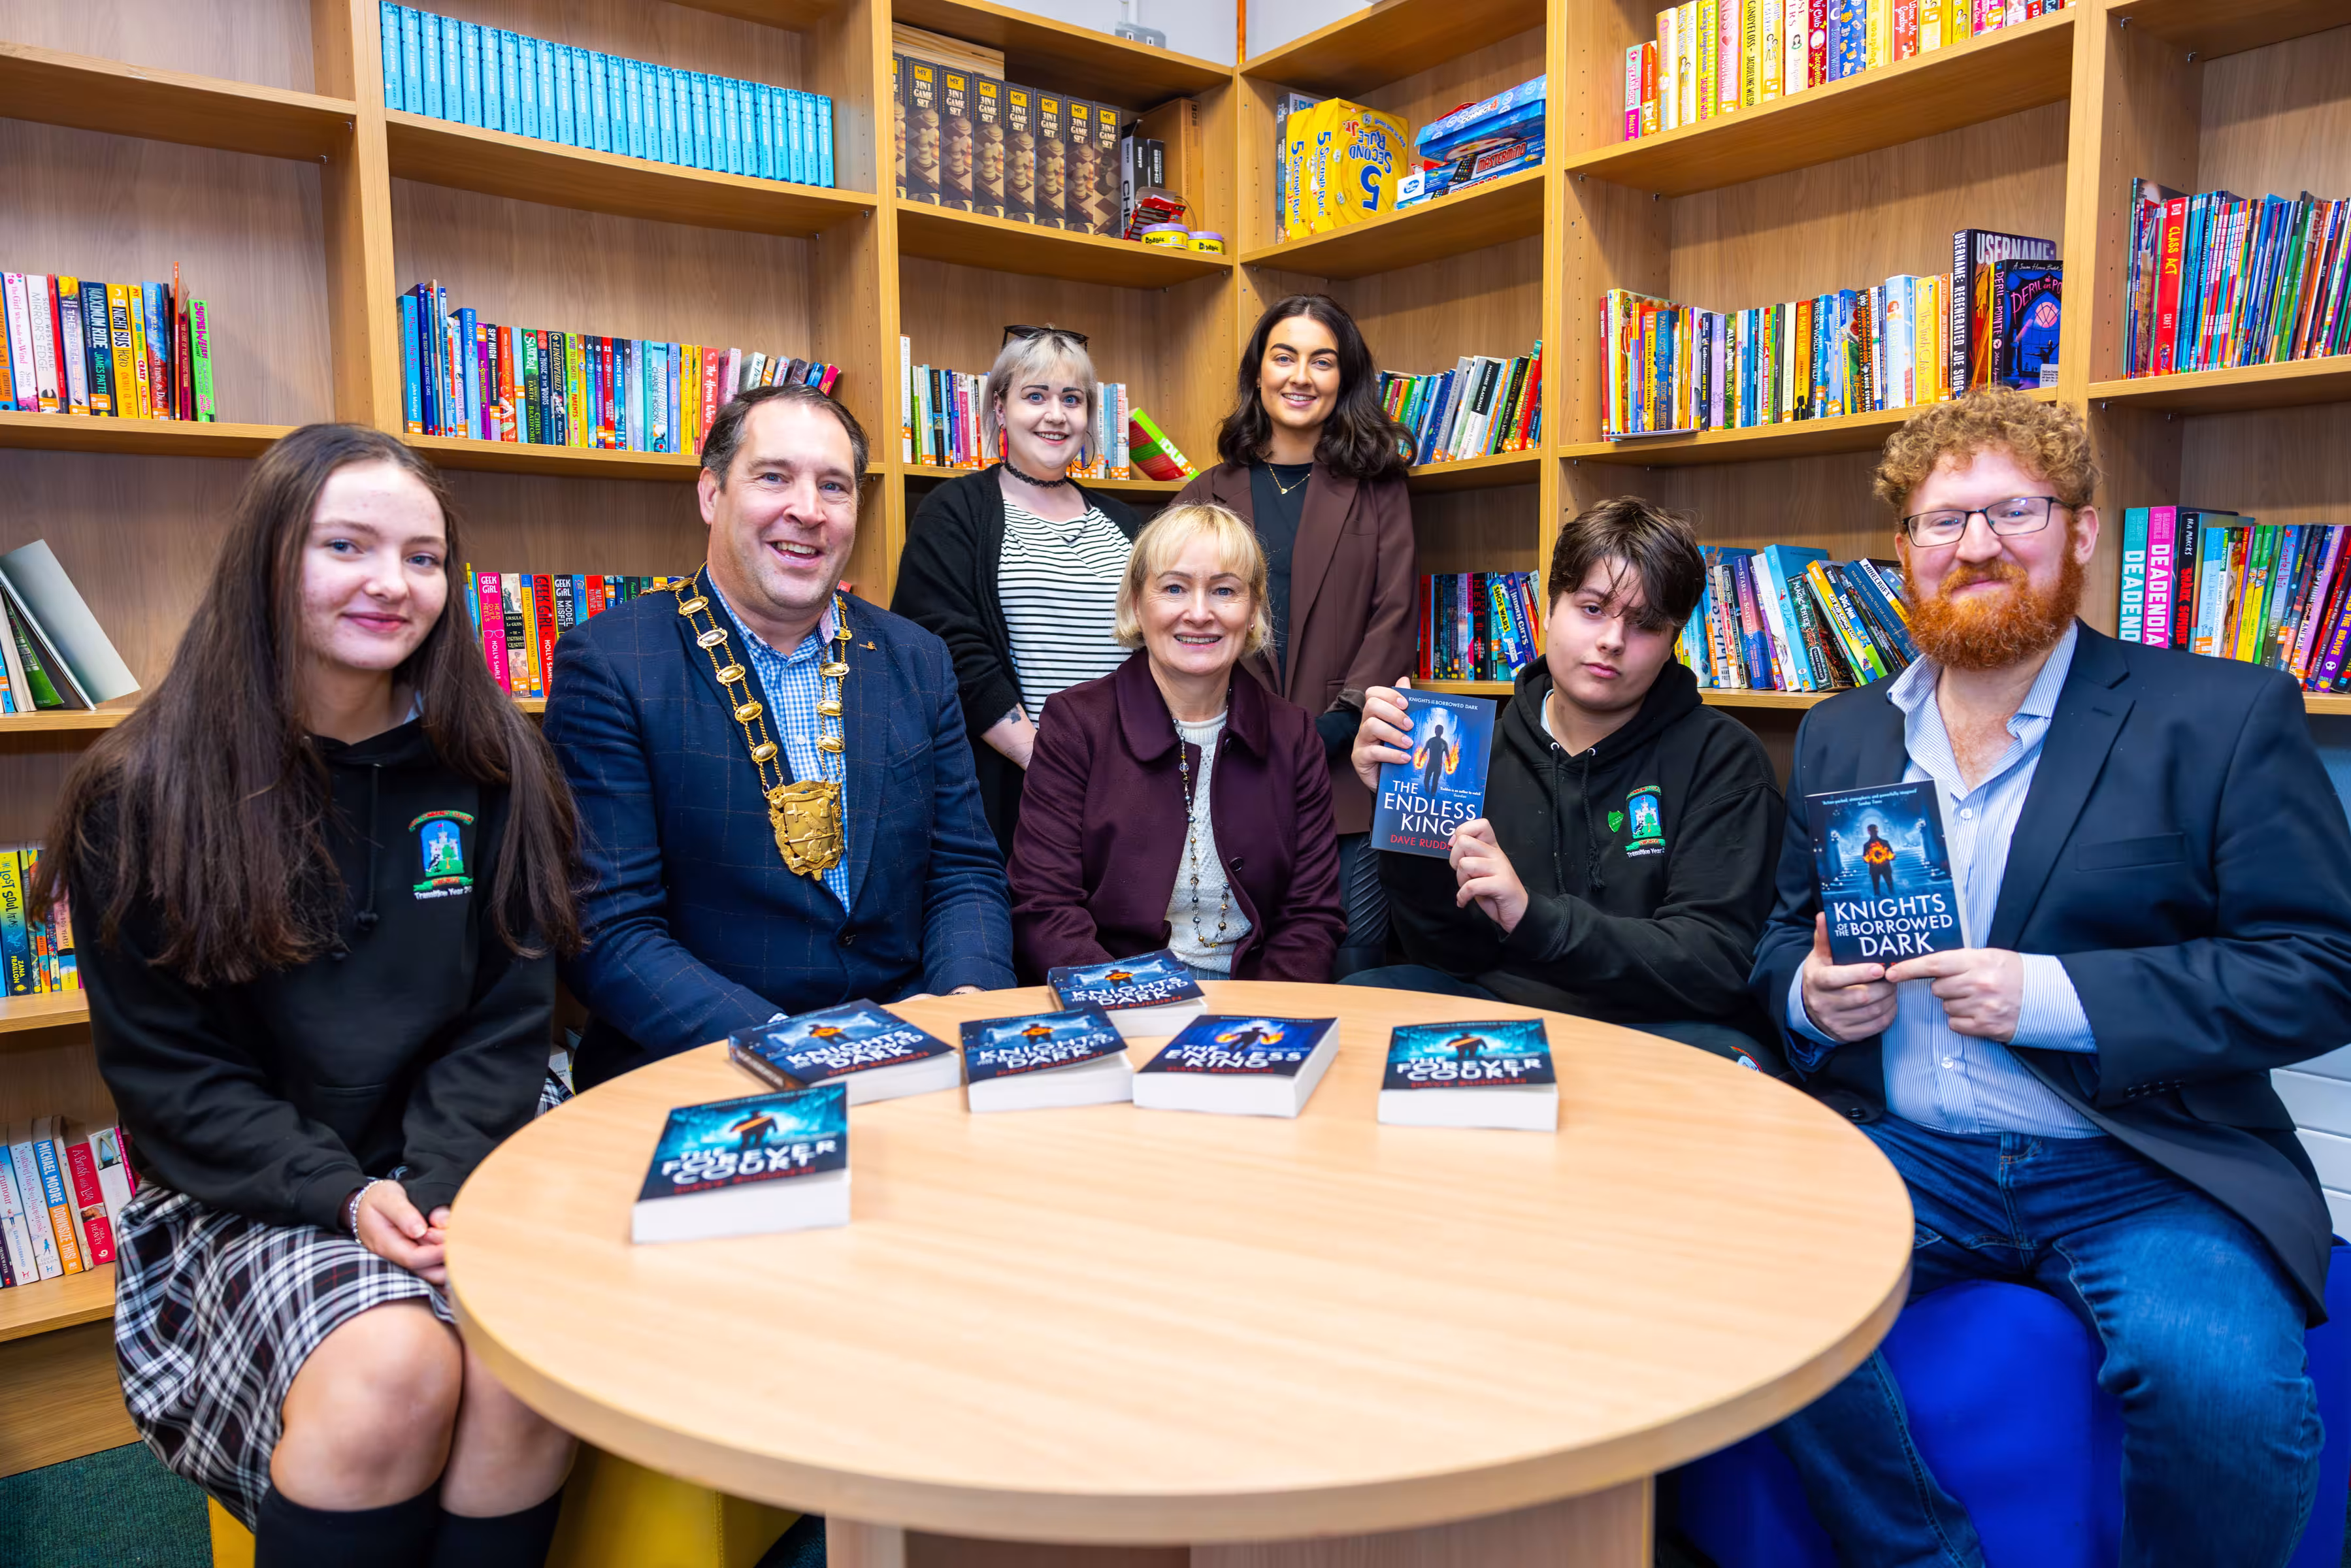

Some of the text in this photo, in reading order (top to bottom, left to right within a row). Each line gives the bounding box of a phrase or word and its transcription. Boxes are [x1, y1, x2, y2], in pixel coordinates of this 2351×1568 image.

[1747, 1, 1756, 48] CANDYFLOSS
[1895, 6, 1907, 33] Goodbye
[1830, 27, 1839, 57] Jacqueline
[913, 89, 932, 100] GAME
[917, 98, 929, 108] SET
[946, 97, 964, 108] GAME
[949, 106, 962, 116] SET
[1010, 113, 1027, 124] GAME
[1013, 122, 1025, 131] SET
[1070, 126, 1088, 137] GAME
[1074, 135, 1085, 144] SET
[1358, 129, 1385, 150] RULE
[1291, 140, 1304, 155] 5
[1349, 144, 1392, 174] SECOND
[1294, 155, 1303, 196] SECOND
[1317, 132, 1332, 217] 5 SECOND RULE
[1360, 165, 1382, 212] 5
[2165, 226, 2181, 276] CLASS ACT
[1800, 305, 1807, 314] NO
[1953, 233, 1965, 391] USERNAME: REGENERATED JOE SUGG
[1994, 271, 2005, 335] PERIL POINTE
[12, 295, 21, 310] Girl
[19, 345, 27, 364] Wind
[31, 292, 48, 371] MIRROR'S EDGE
[88, 287, 108, 349] MAXIMUM RIDE
[112, 308, 129, 348] NIGHT BUS
[2163, 314, 2172, 329] CRAFT
[46, 324, 54, 368] WESTERFELD
[67, 310, 78, 361] THE TRUTH
[94, 351, 105, 373] JAMES
[138, 360, 146, 380] CRAZY
[540, 357, 550, 405] HOUSE WOODS
[705, 365, 715, 423] The Henna Wars
[1475, 365, 1493, 412] MALORIE BLACKMAN
[2184, 531, 2194, 555] MARCKS
[481, 576, 497, 585] GEEK
[535, 576, 550, 603] GEEK
[555, 579, 570, 588] GEEK
[1793, 582, 1803, 605] MAGIC
[1864, 564, 1892, 597] MINECRAFT
[1739, 571, 1753, 639] STARS SCATTERED
[2146, 544, 2170, 645] DEADENDIA
[557, 600, 566, 627] MISFIT
[565, 600, 573, 627] MODEL
[1493, 586, 1511, 631] SHOE WARS
[1510, 591, 1529, 645] HIDDEN GIFTS
[2331, 630, 2347, 656] BRAVE
[1392, 780, 1418, 794] THE
[1384, 792, 1476, 821] ENDLESS
[1401, 813, 1455, 836] KING
[1390, 835, 1416, 846] DAVE
[1626, 849, 1651, 858] Transition
[2, 890, 18, 912] SOUL
[1833, 893, 1946, 922] KNIGHTS
[1850, 914, 1952, 936] BORROWED
[1858, 932, 1934, 956] DARK
[10, 956, 20, 983] FRAILLON
[1072, 977, 1181, 998] KNIGHTS
[1097, 990, 1172, 1005] DARK
[787, 1030, 912, 1064] KNIGHTS
[827, 1046, 914, 1068] DARK
[1164, 1049, 1302, 1062] ENDLESS
[1185, 1056, 1269, 1068] KING
[1397, 1058, 1542, 1073] FOREVER
[1407, 1067, 1524, 1081] COURT
[661, 1139, 836, 1176] FOREVER
[672, 1153, 816, 1184] COURT
[37, 1141, 63, 1204] MICHAEL MOORE
[54, 1207, 76, 1262] DOWNSIZE THIS!
[90, 1224, 102, 1245] HEAVEY
